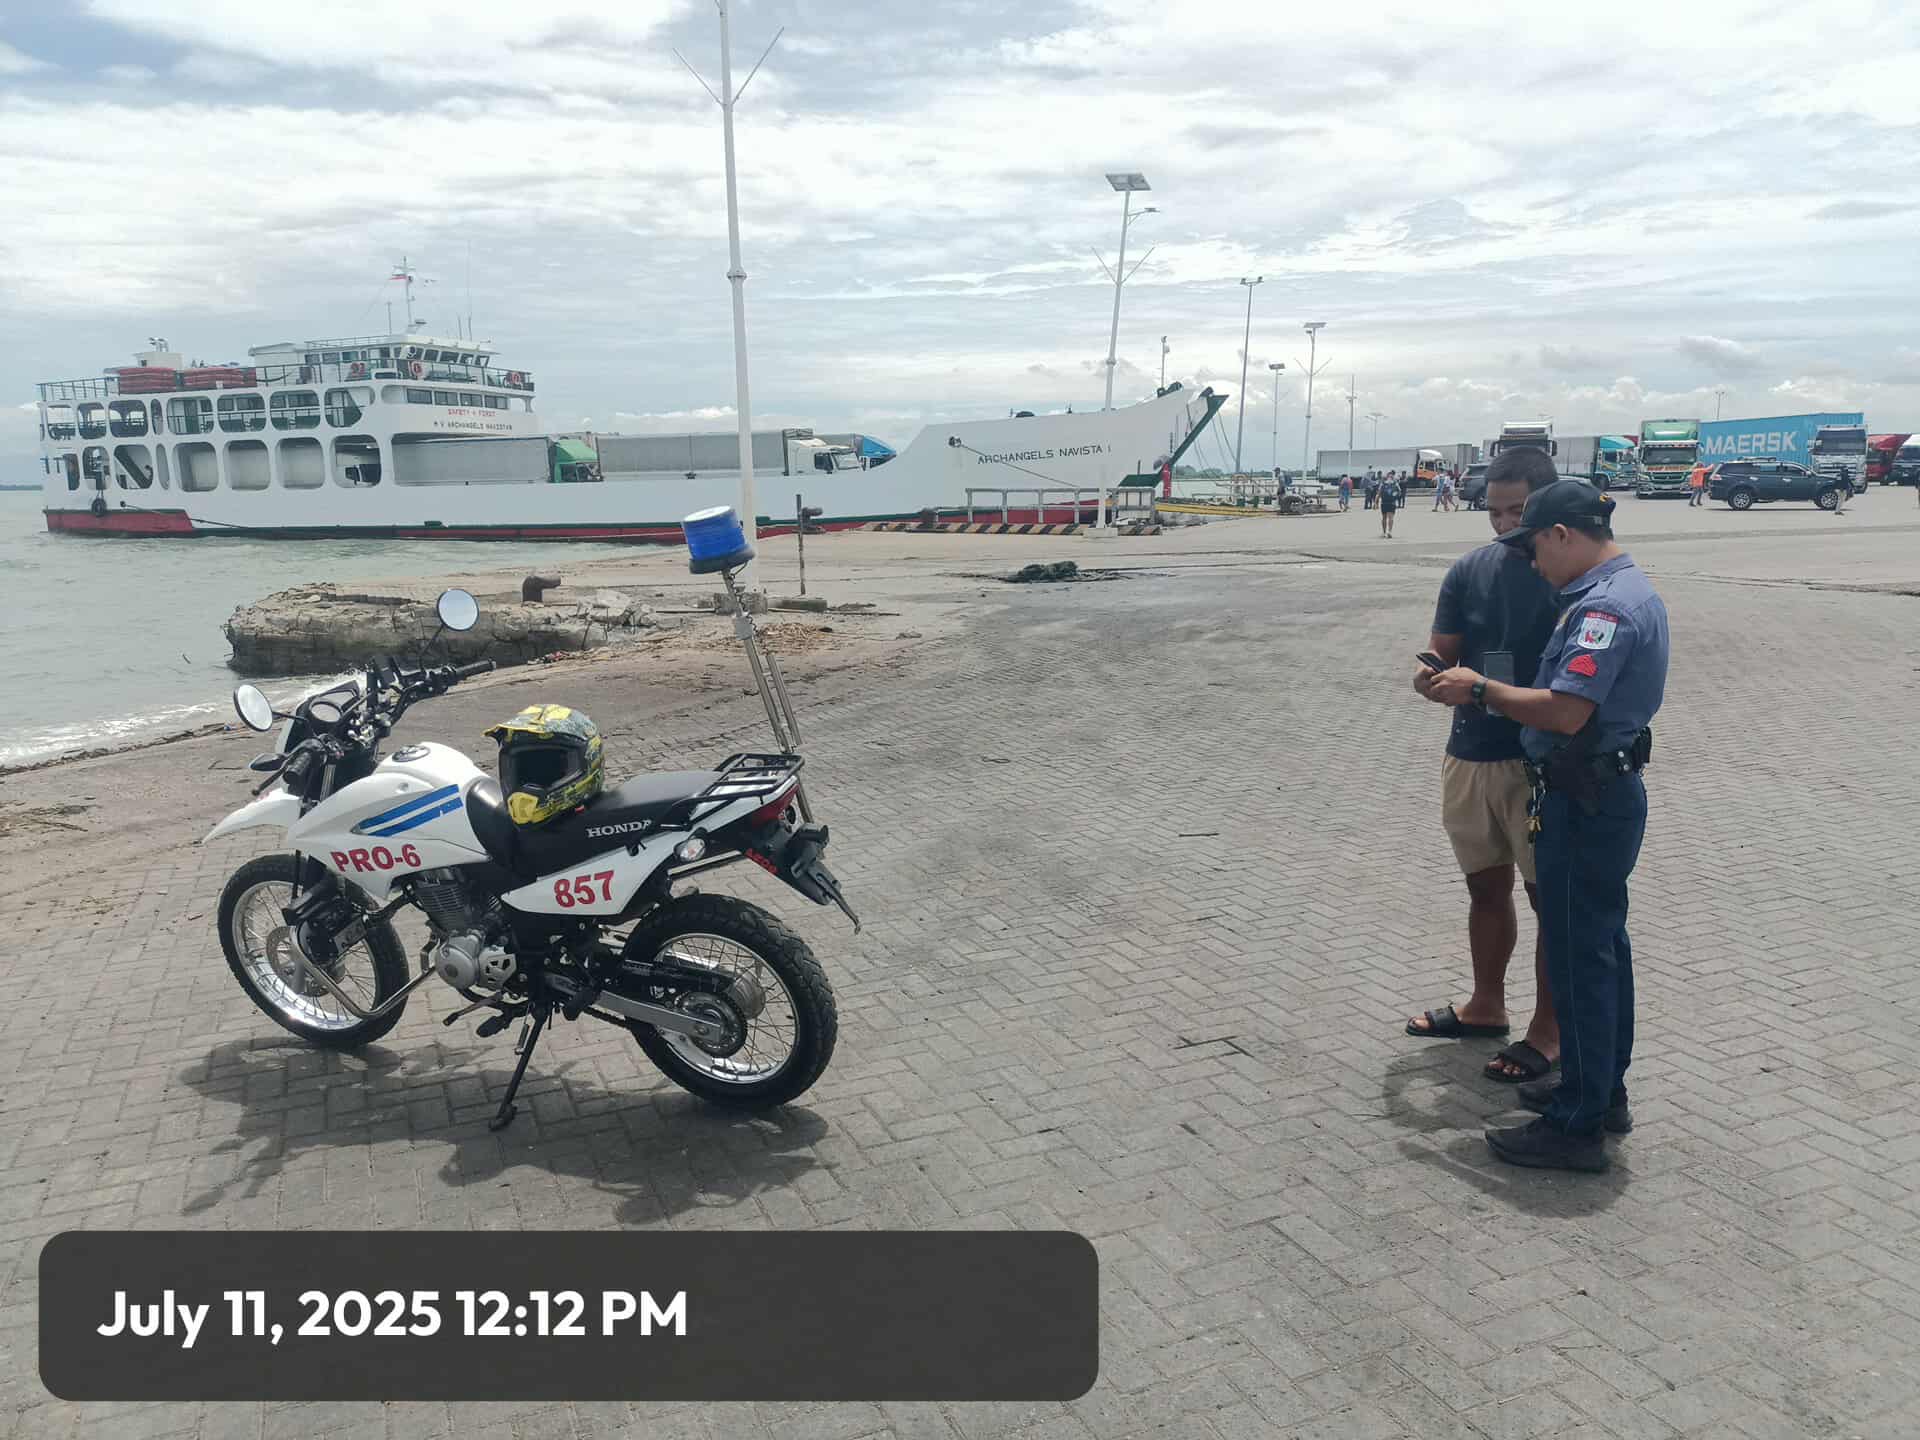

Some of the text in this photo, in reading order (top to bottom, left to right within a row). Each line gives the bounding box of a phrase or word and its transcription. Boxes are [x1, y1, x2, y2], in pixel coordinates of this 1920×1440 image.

[977, 449, 1055, 465] ARCHANGELS
[1059, 444, 1103, 457] NAVISTA
[1703, 431, 1798, 456] MAERSK
[584, 819, 652, 838] HONDA
[329, 843, 422, 873] PRO-6
[553, 870, 615, 908] 857
